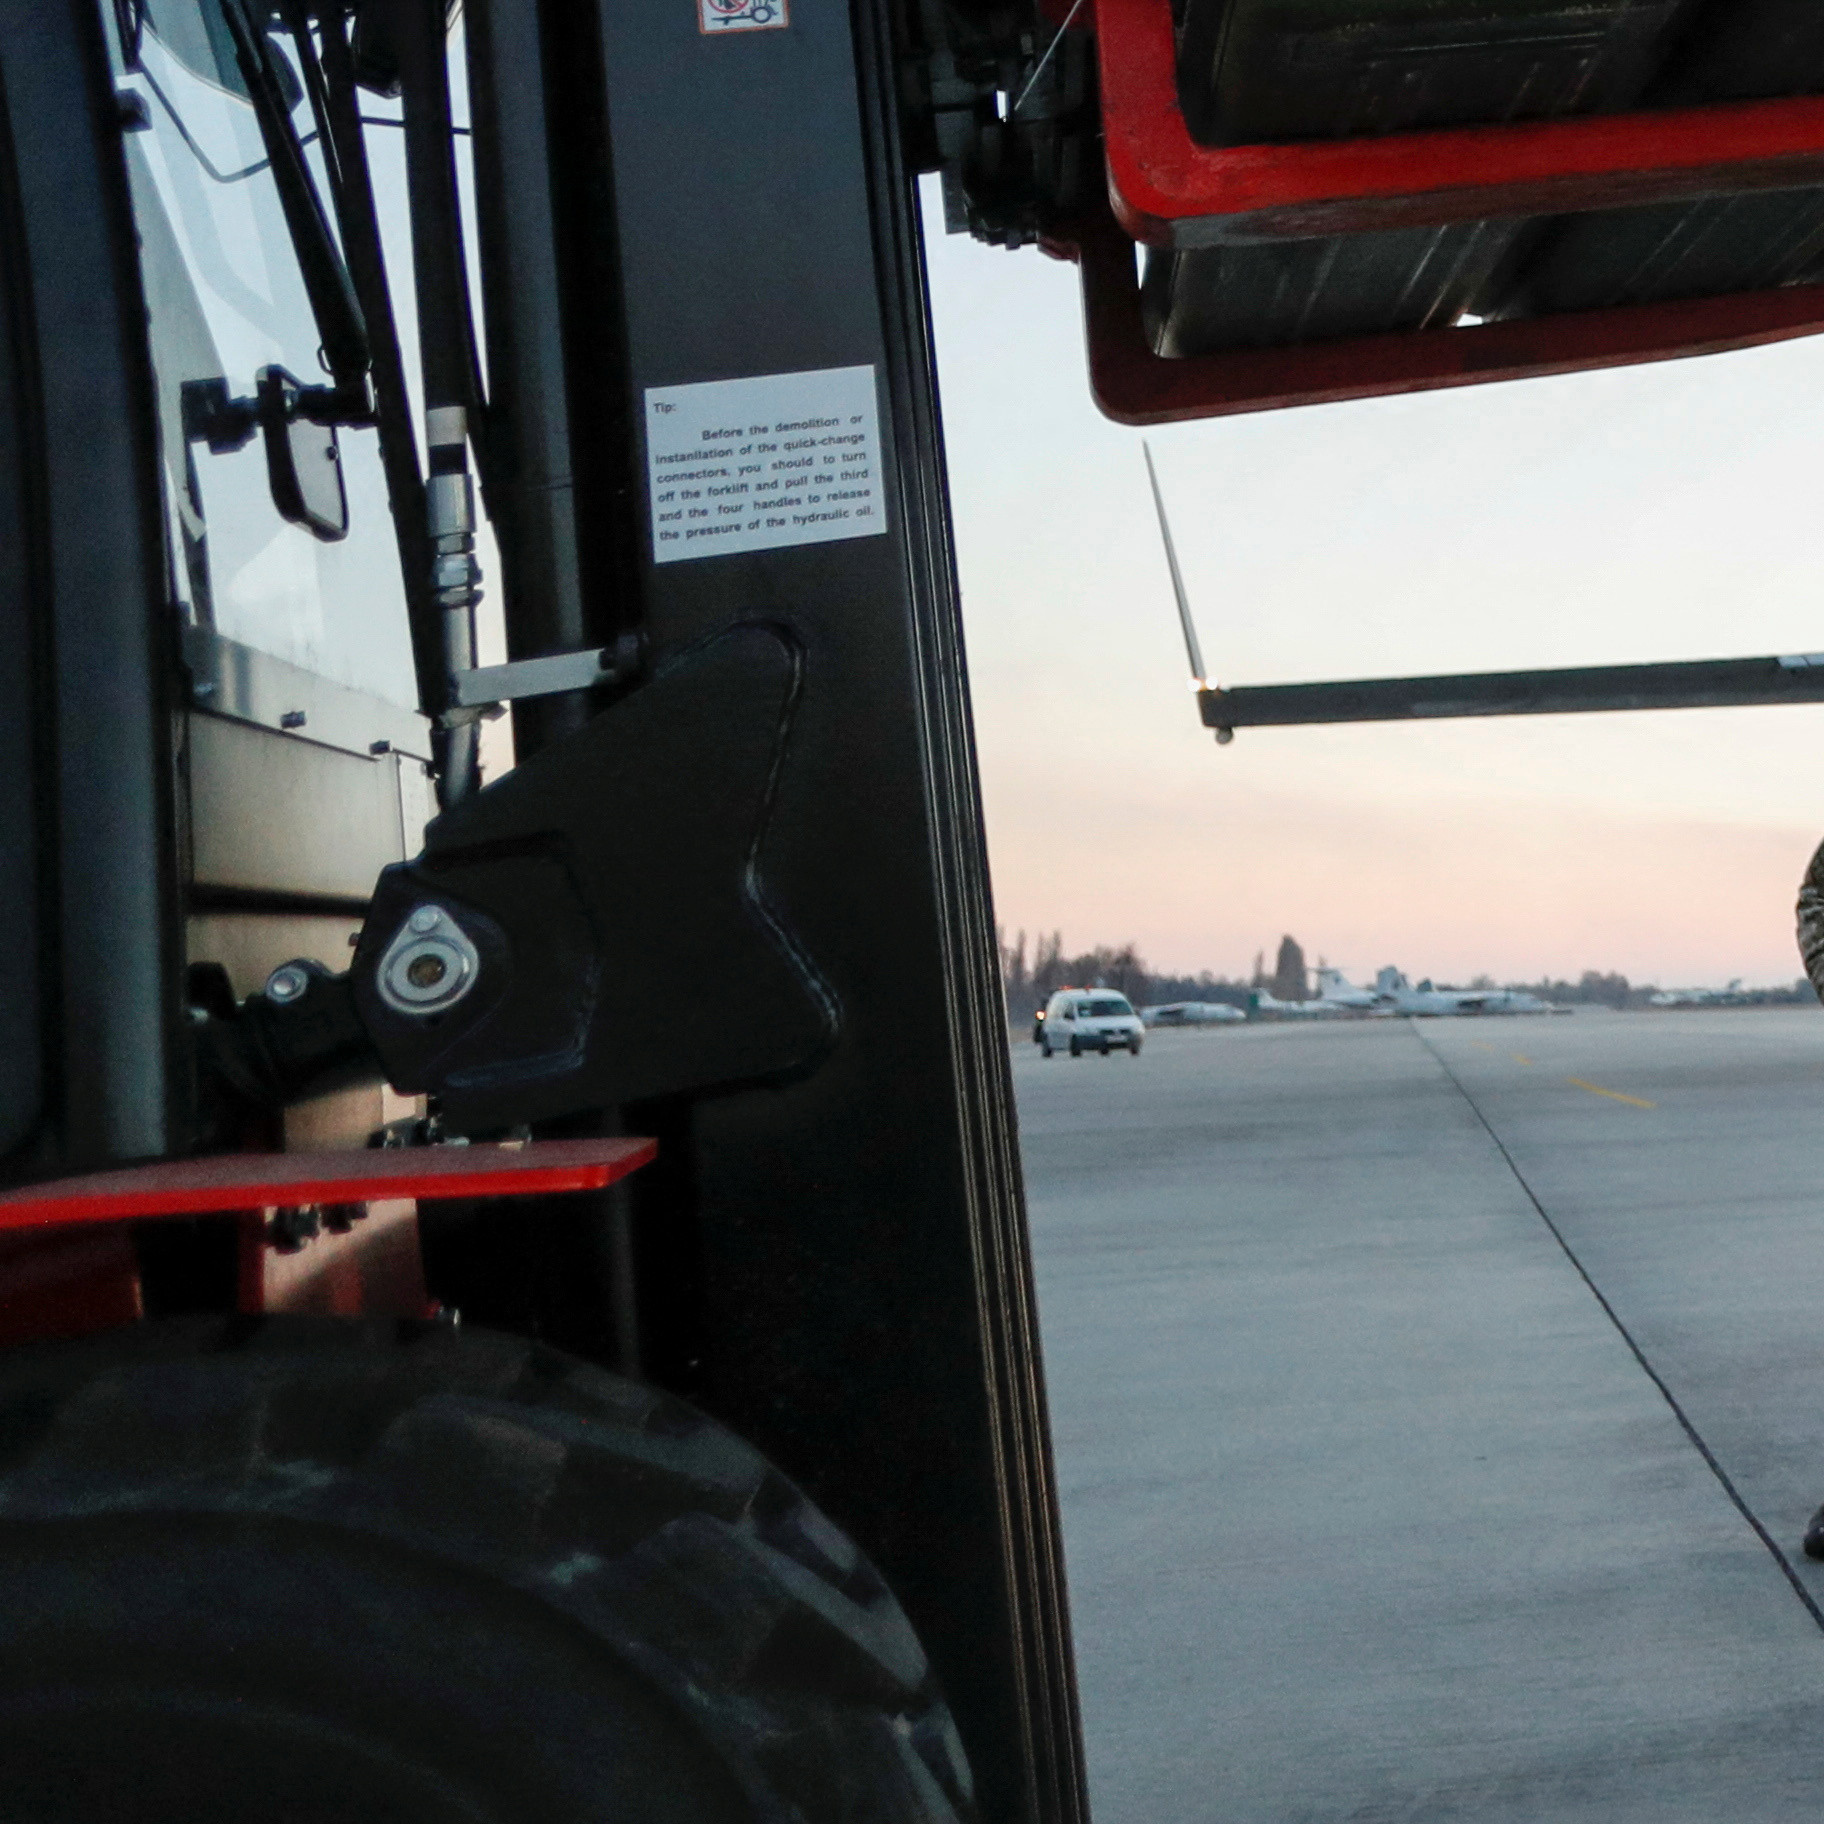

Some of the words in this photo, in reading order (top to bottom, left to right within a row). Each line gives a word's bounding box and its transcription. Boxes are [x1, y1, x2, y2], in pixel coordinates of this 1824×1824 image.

[653, 402, 677, 414] Tip:
[702, 425, 743, 441] Before
[749, 424, 768, 436] the
[775, 417, 839, 433] demolition
[850, 414, 863, 424] or
[740, 445, 752, 456] of
[758, 441, 777, 453] the
[783, 433, 865, 452] quick-change
[657, 467, 730, 484] connectors,
[738, 464, 761, 476] you
[771, 457, 813, 471] should
[823, 454, 835, 464] to
[842, 451, 866, 463] turn
[657, 491, 675, 503] off
[681, 488, 701, 499] the
[707, 482, 748, 497] forklift
[755, 480, 779, 492] and
[784, 475, 808, 488] pull
[814, 471, 833, 484] the
[840, 468, 869, 480] third
[658, 510, 682, 522] and
[689, 506, 708, 518] the
[717, 503, 744, 516] four
[753, 496, 801, 511] handles
[808, 493, 820, 503] to
[827, 488, 871, 502] release
[659, 528, 679, 541] the
[686, 523, 742, 540] pressure
[747, 518, 761, 530] of
[766, 515, 786, 527] the
[792, 509, 850, 526] hydraulic
[856, 505, 874, 517] oil.
